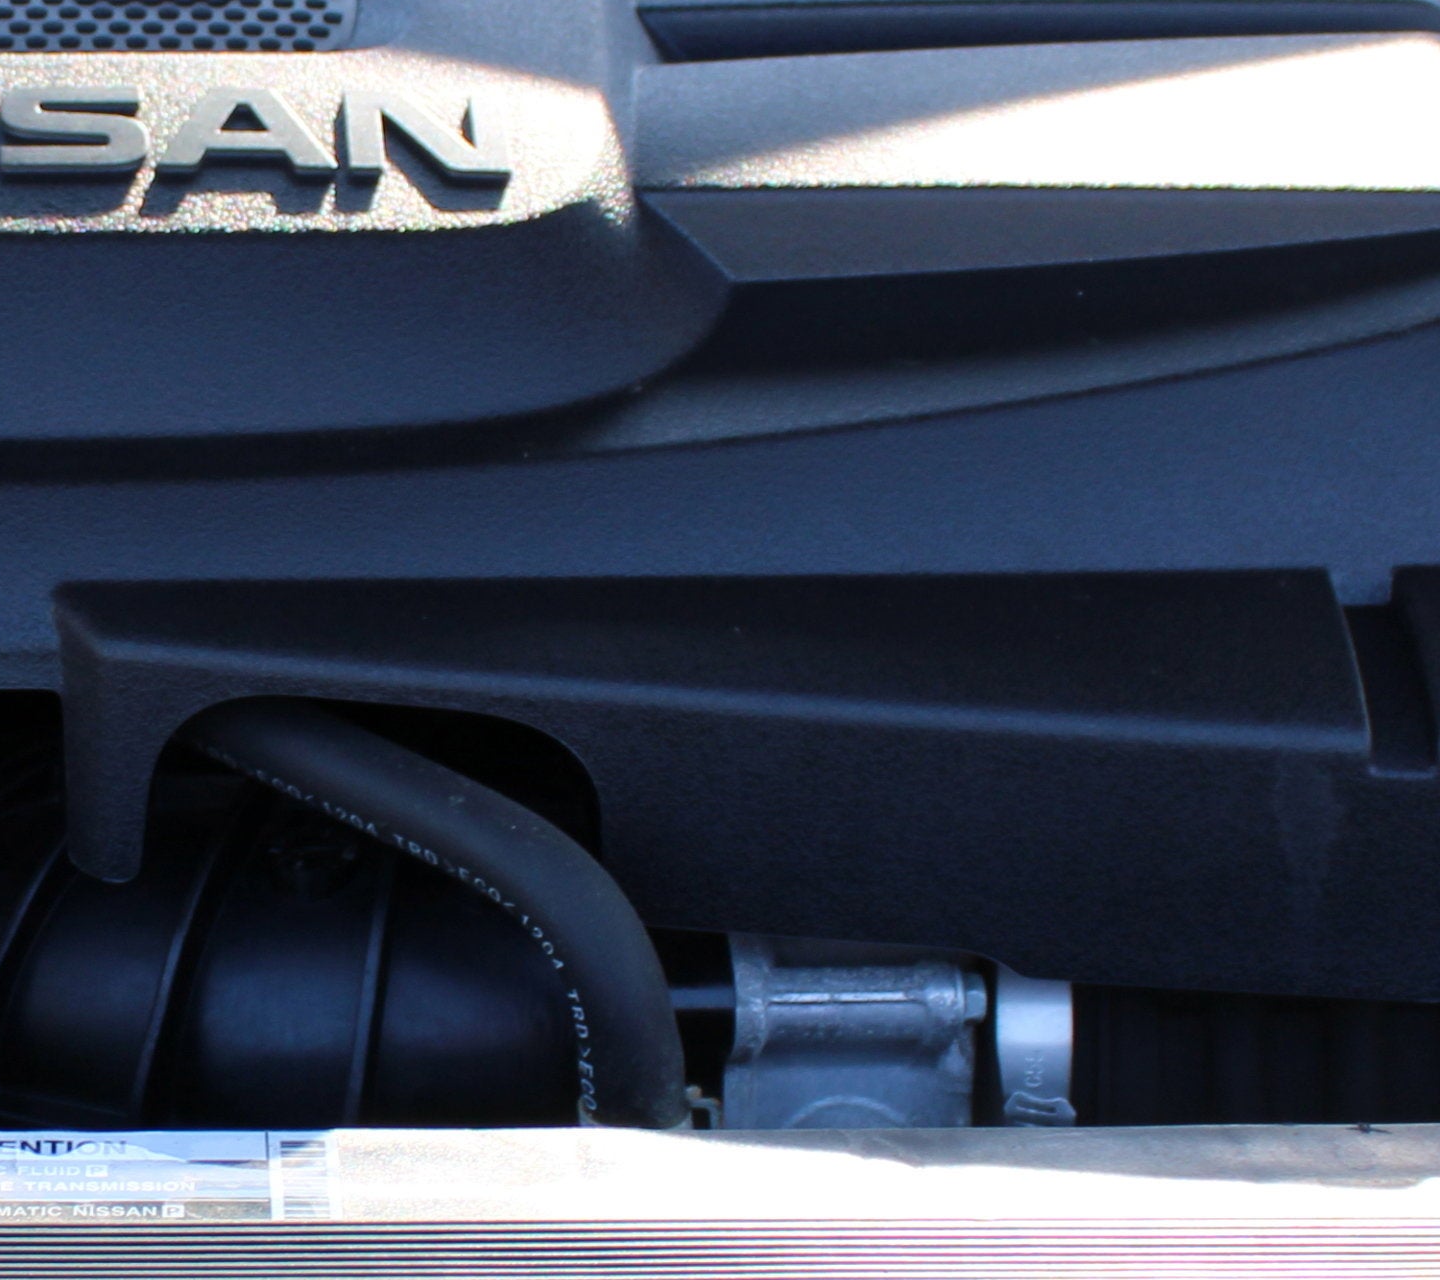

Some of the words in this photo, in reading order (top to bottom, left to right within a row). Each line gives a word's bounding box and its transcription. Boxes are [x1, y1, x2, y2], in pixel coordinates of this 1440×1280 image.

[17, 1166, 82, 1176] FLUID
[23, 1181, 196, 1191] TRANSMISSION
[71, 1205, 158, 1217] NISSAN
